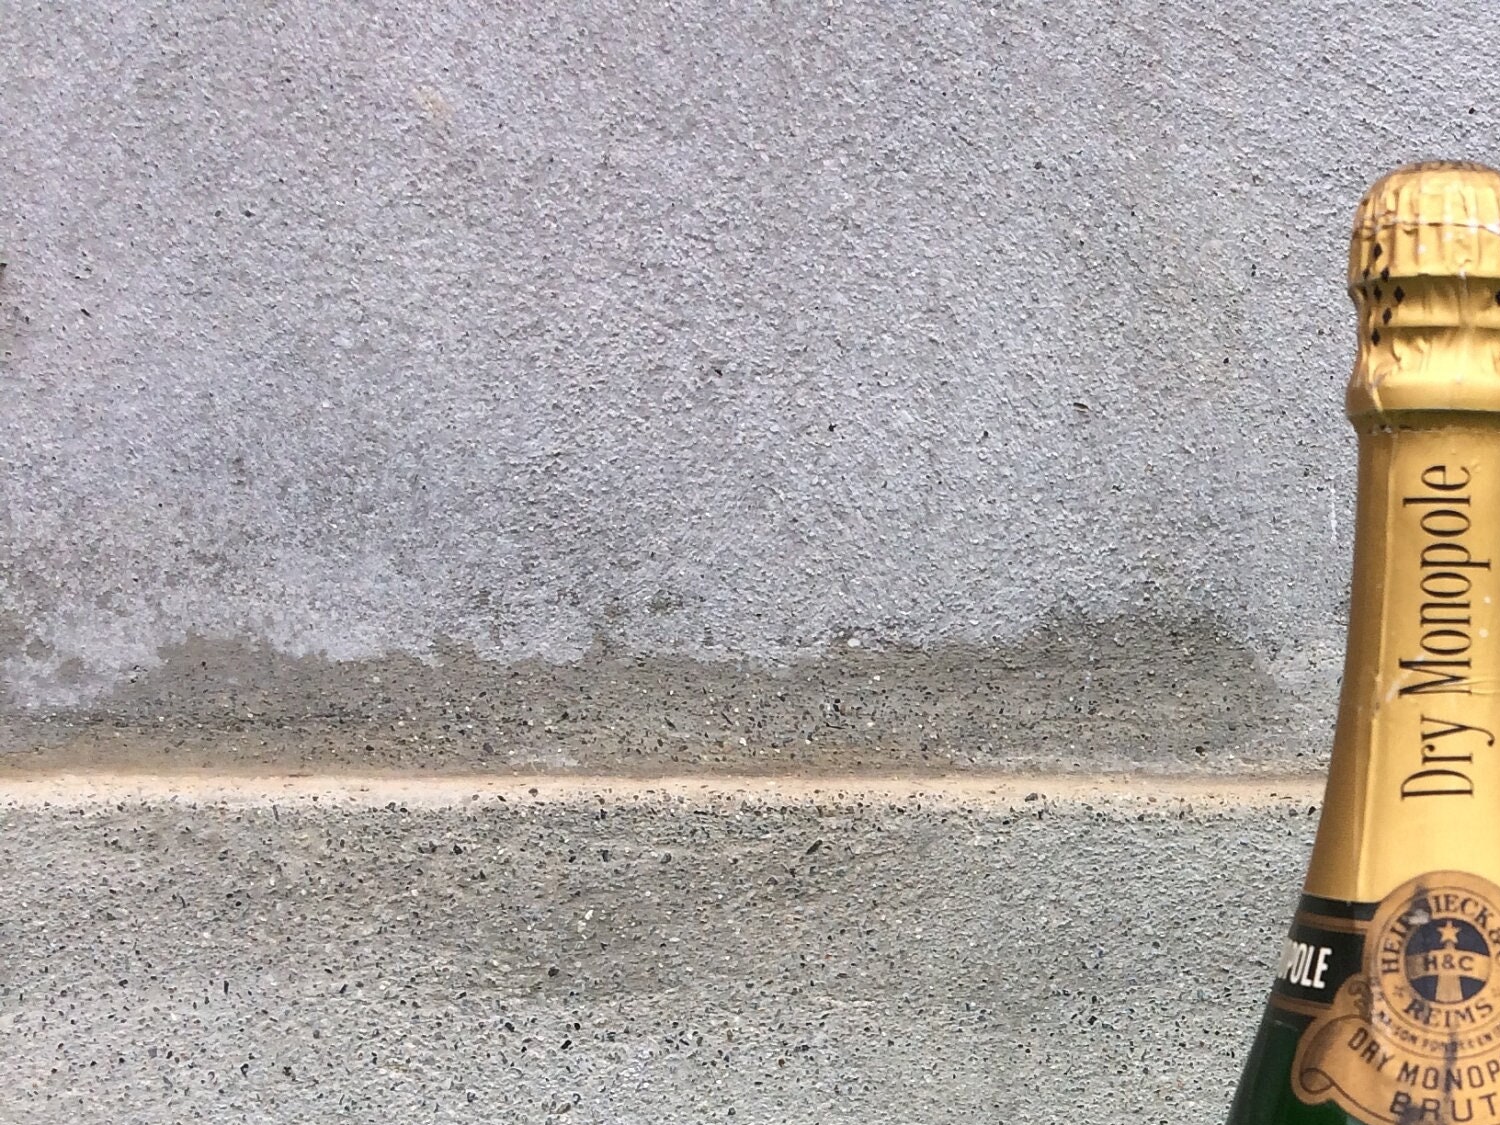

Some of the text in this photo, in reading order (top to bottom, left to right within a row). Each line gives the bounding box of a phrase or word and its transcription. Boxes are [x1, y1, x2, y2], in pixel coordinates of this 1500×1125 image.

[1398, 464, 1495, 801] Dry Monopole
[1403, 999, 1493, 1028] REIMS
[1347, 1027, 1395, 1072] DRY
[1389, 1091, 1498, 1123] BRUT
